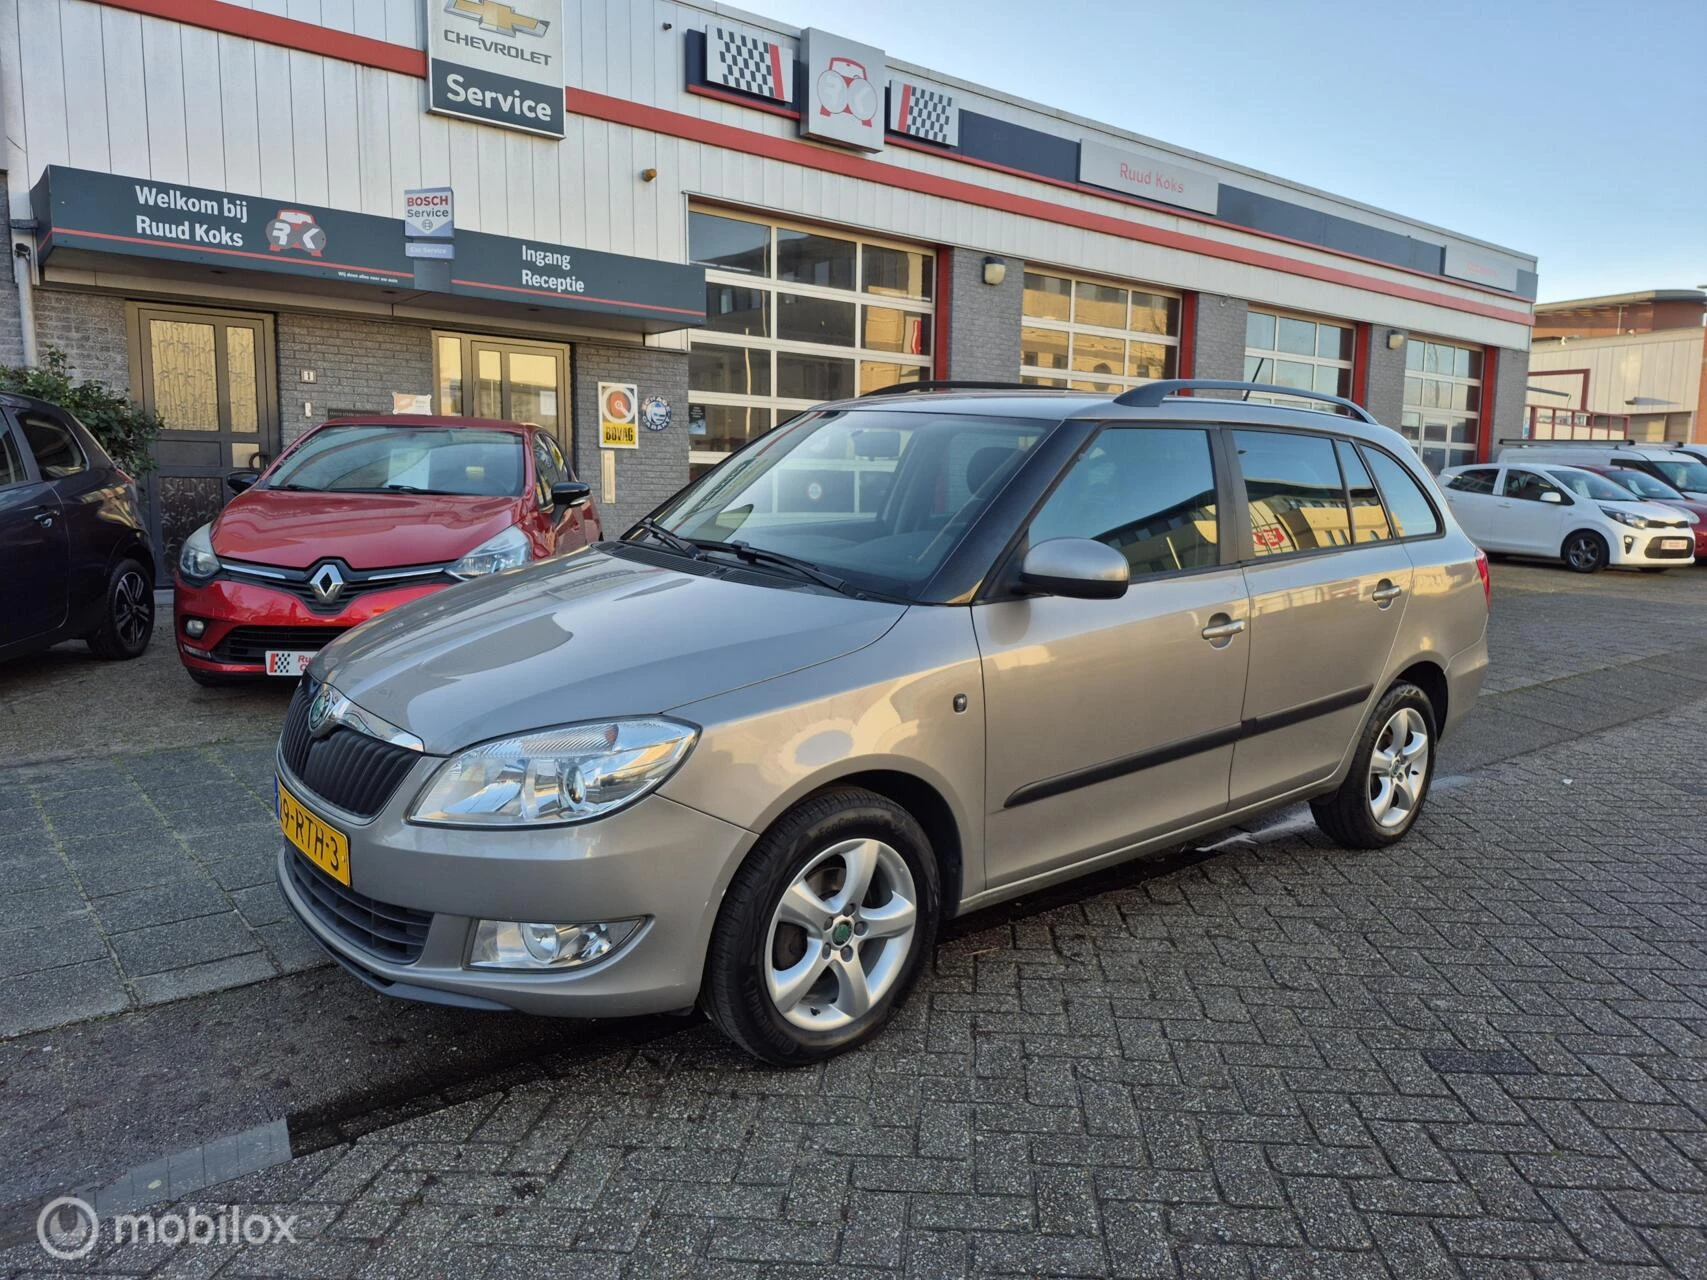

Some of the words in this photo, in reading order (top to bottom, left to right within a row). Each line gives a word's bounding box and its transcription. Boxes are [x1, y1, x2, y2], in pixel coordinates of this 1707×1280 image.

[444, 29, 552, 66] CHEVROLET
[446, 73, 552, 121] Service
[1120, 162, 1152, 184] Ruud
[1155, 172, 1184, 193] Koks
[135, 185, 219, 216] Welkom
[223, 197, 248, 224] bij
[407, 195, 449, 207] BOSCH
[407, 208, 449, 218] Service
[136, 215, 190, 241] Ruud
[195, 223, 244, 247] Koks
[423, 247, 446, 255] Service
[522, 244, 571, 270] Ingang
[521, 269, 585, 293] Receptie
[606, 427, 633, 442] BOVAG
